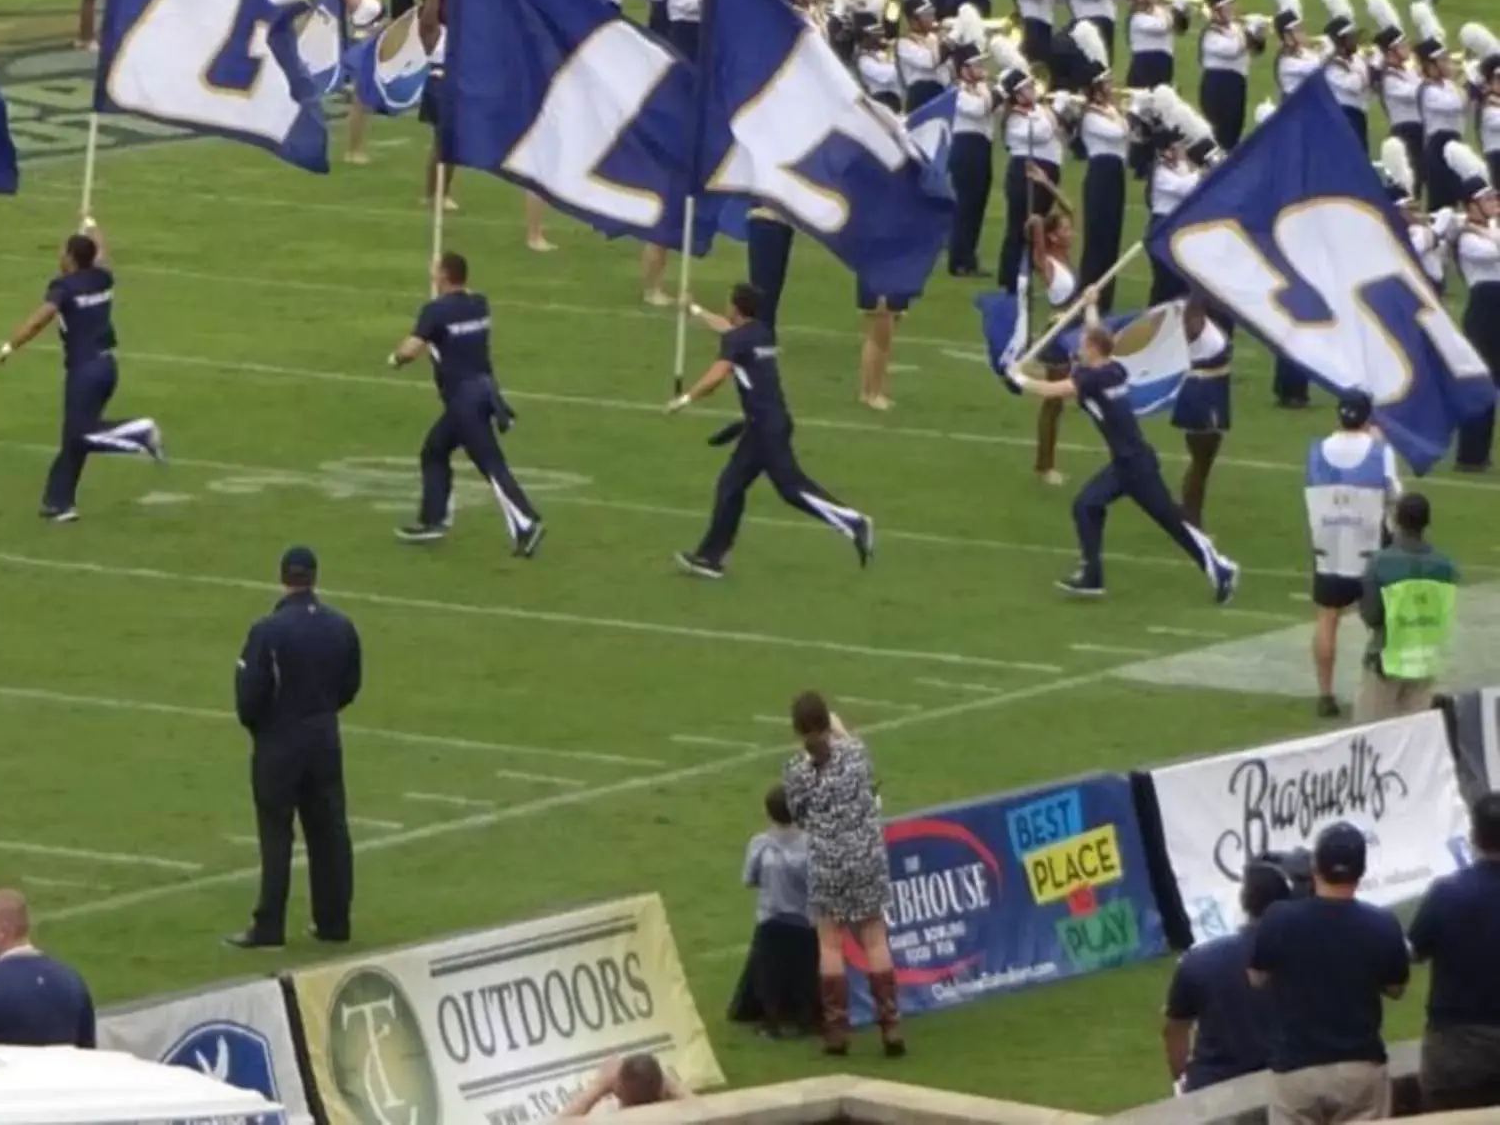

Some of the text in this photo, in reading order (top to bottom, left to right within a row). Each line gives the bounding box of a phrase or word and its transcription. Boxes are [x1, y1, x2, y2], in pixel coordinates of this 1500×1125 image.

[500, 17, 677, 229] L
[703, 19, 910, 234] E
[1170, 195, 1491, 406] S
[1014, 797, 1072, 850] BEST
[1032, 835, 1115, 896] PLACE
[1213, 734, 1410, 884] Braswell's
[882, 861, 990, 928] UBHOUSE
[1066, 909, 1130, 957] PLAY
[436, 950, 655, 1065] OUTDOORS
